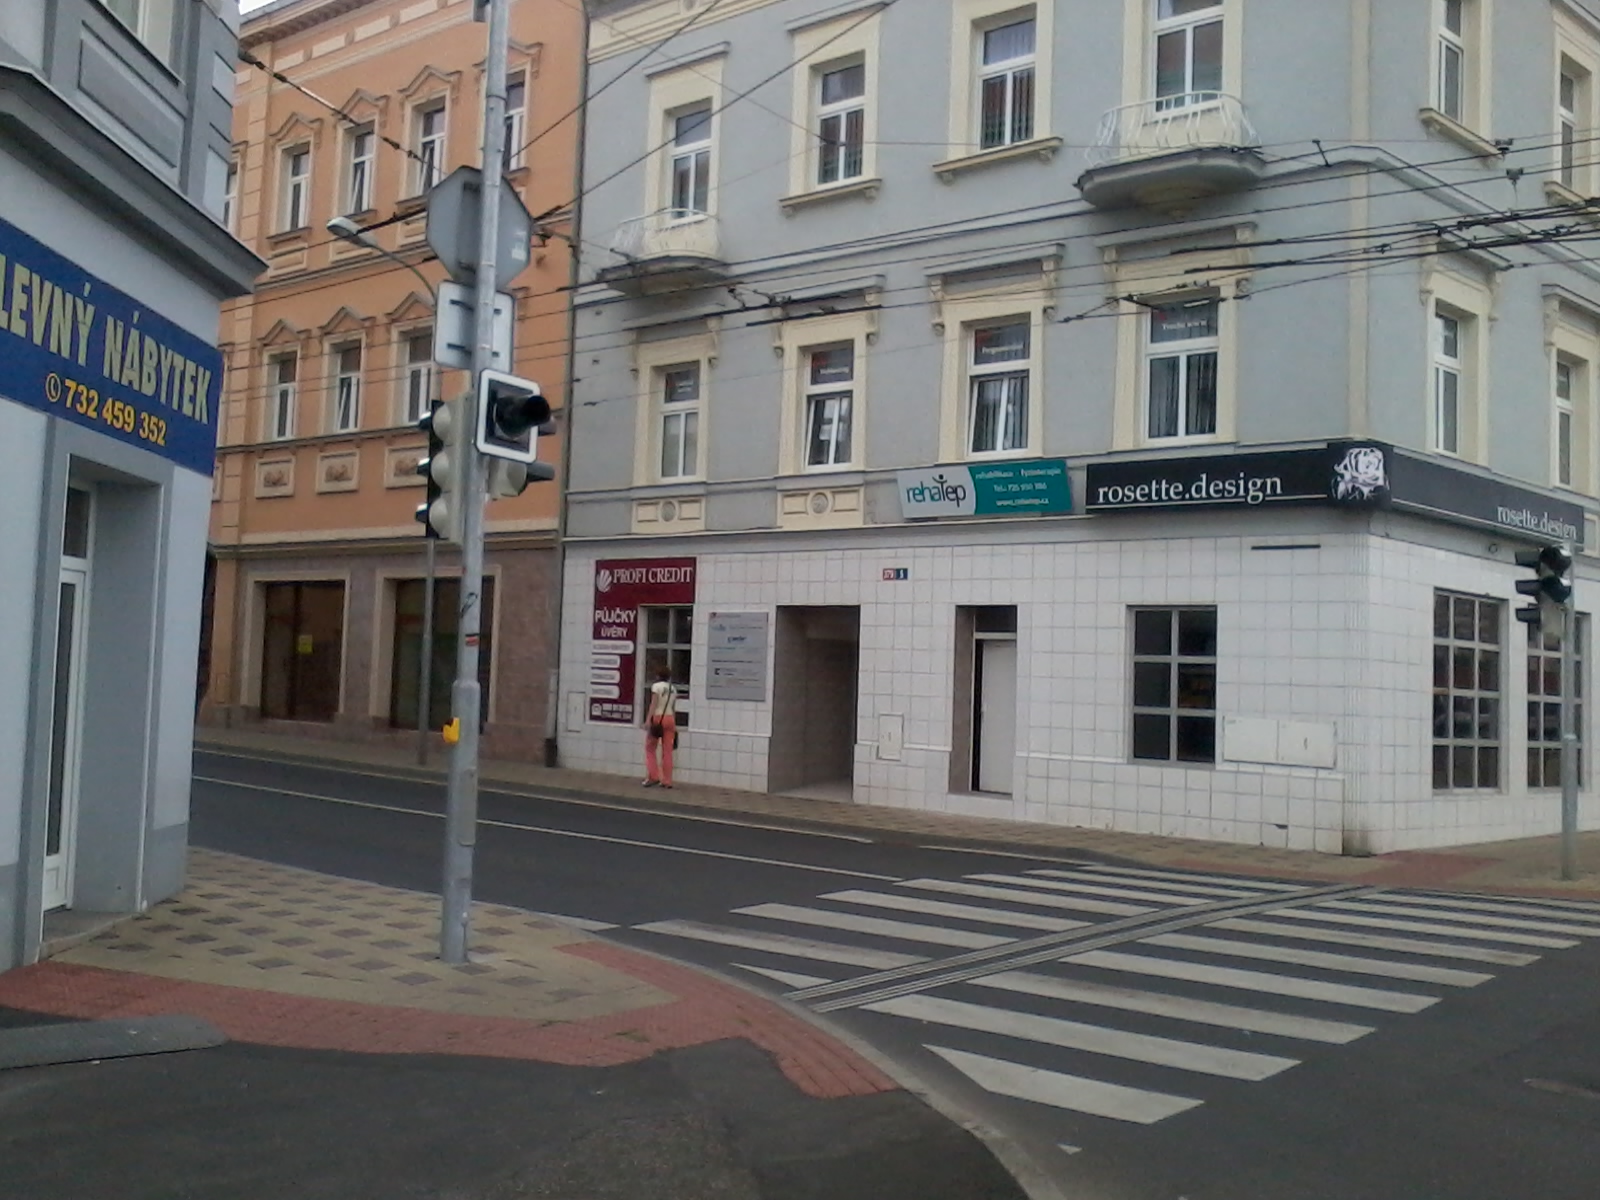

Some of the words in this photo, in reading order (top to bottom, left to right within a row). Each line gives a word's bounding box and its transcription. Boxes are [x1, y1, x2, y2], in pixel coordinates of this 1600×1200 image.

[0, 253, 95, 367] LEVNÝ
[103, 310, 211, 424] NÁBYTEK
[64, 379, 98, 419] 732
[102, 397, 135, 433] 459
[138, 411, 167, 446] 352
[1097, 472, 1282, 504] rosette.design
[1497, 506, 1577, 540] rosette.design
[613, 567, 647, 584] PROFI
[648, 566, 693, 583] CREDIT
[595, 606, 637, 623] PŮJČKY
